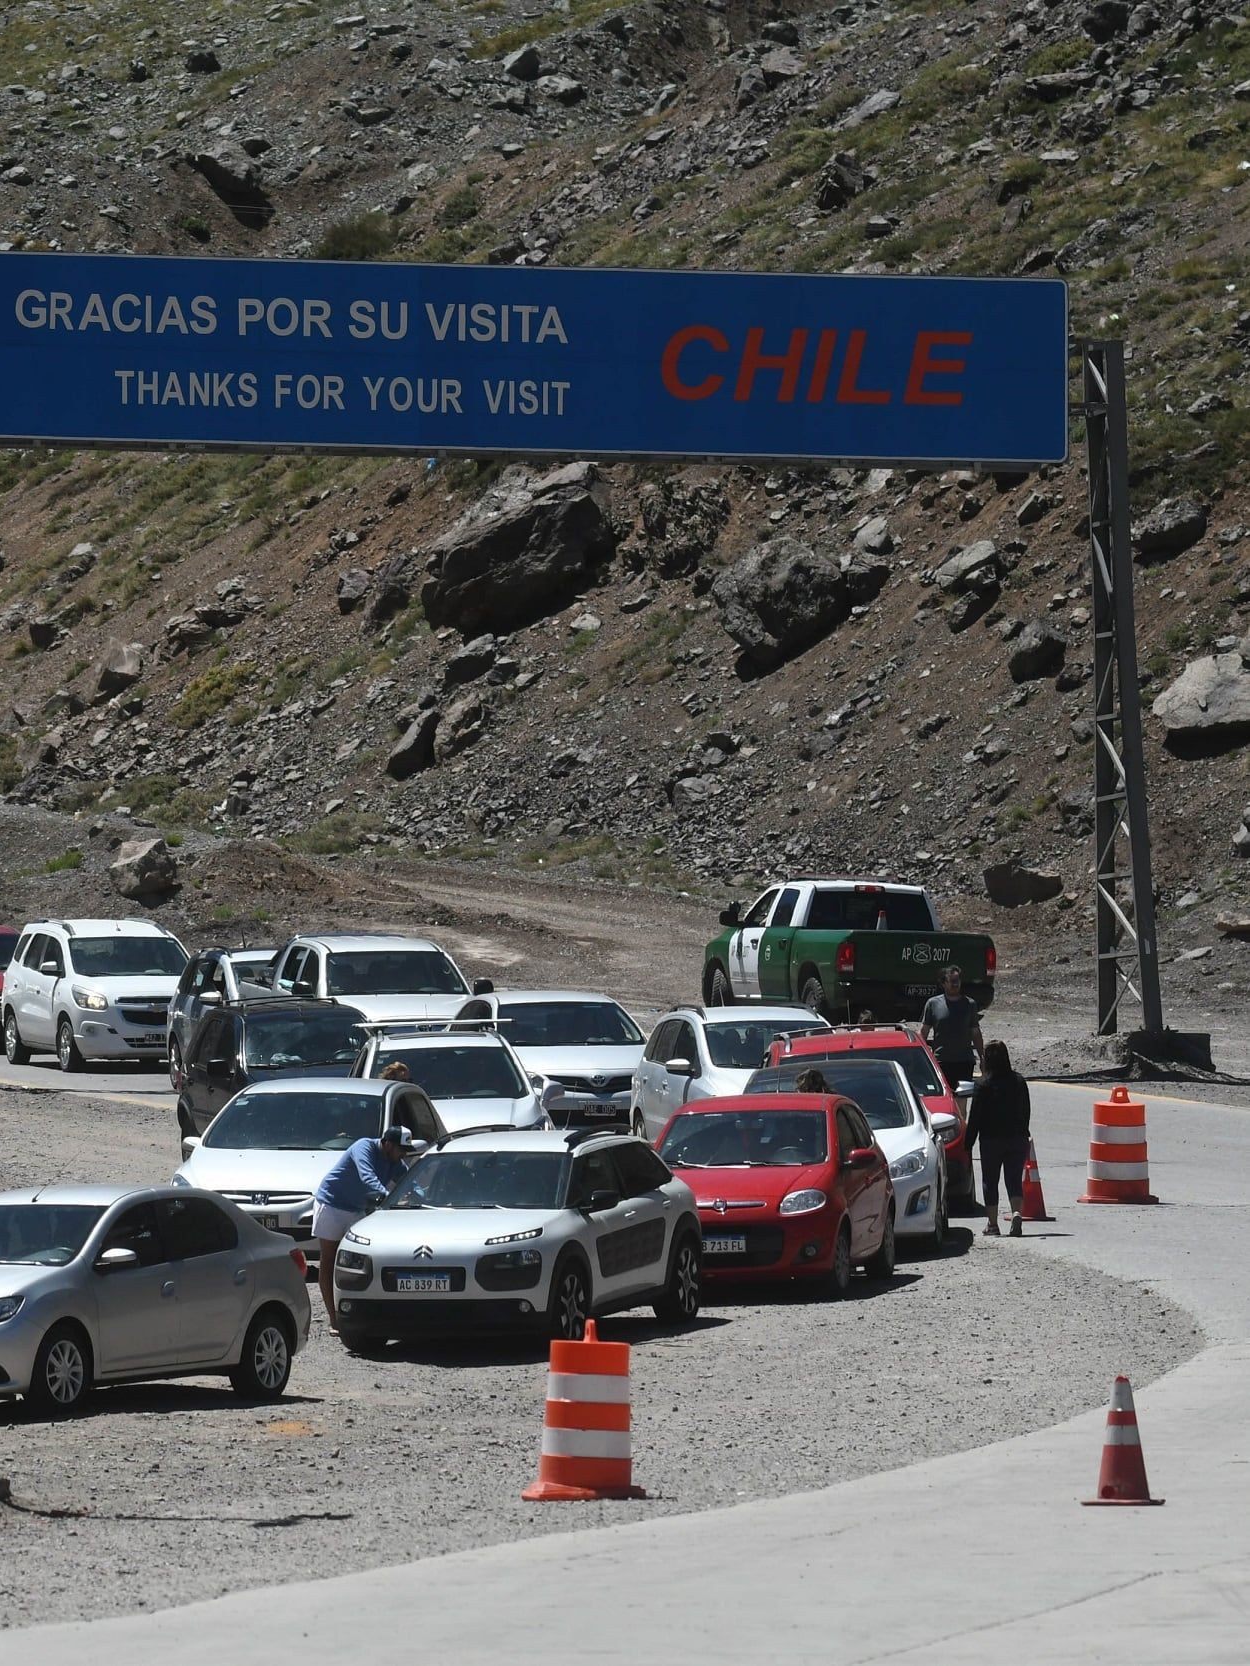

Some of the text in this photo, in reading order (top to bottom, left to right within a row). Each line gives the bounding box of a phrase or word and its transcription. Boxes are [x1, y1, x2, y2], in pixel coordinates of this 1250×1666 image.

[14, 288, 569, 344] GRACIAS POR SU VISITA
[660, 324, 974, 406] CHILE
[114, 370, 571, 416] THANKS FOR YOUR VISIT
[901, 947, 951, 961] AP 2077
[710, 1241, 728, 1251] 713
[731, 1241, 743, 1251] FL
[399, 1279, 448, 1290] AC 839 RT
